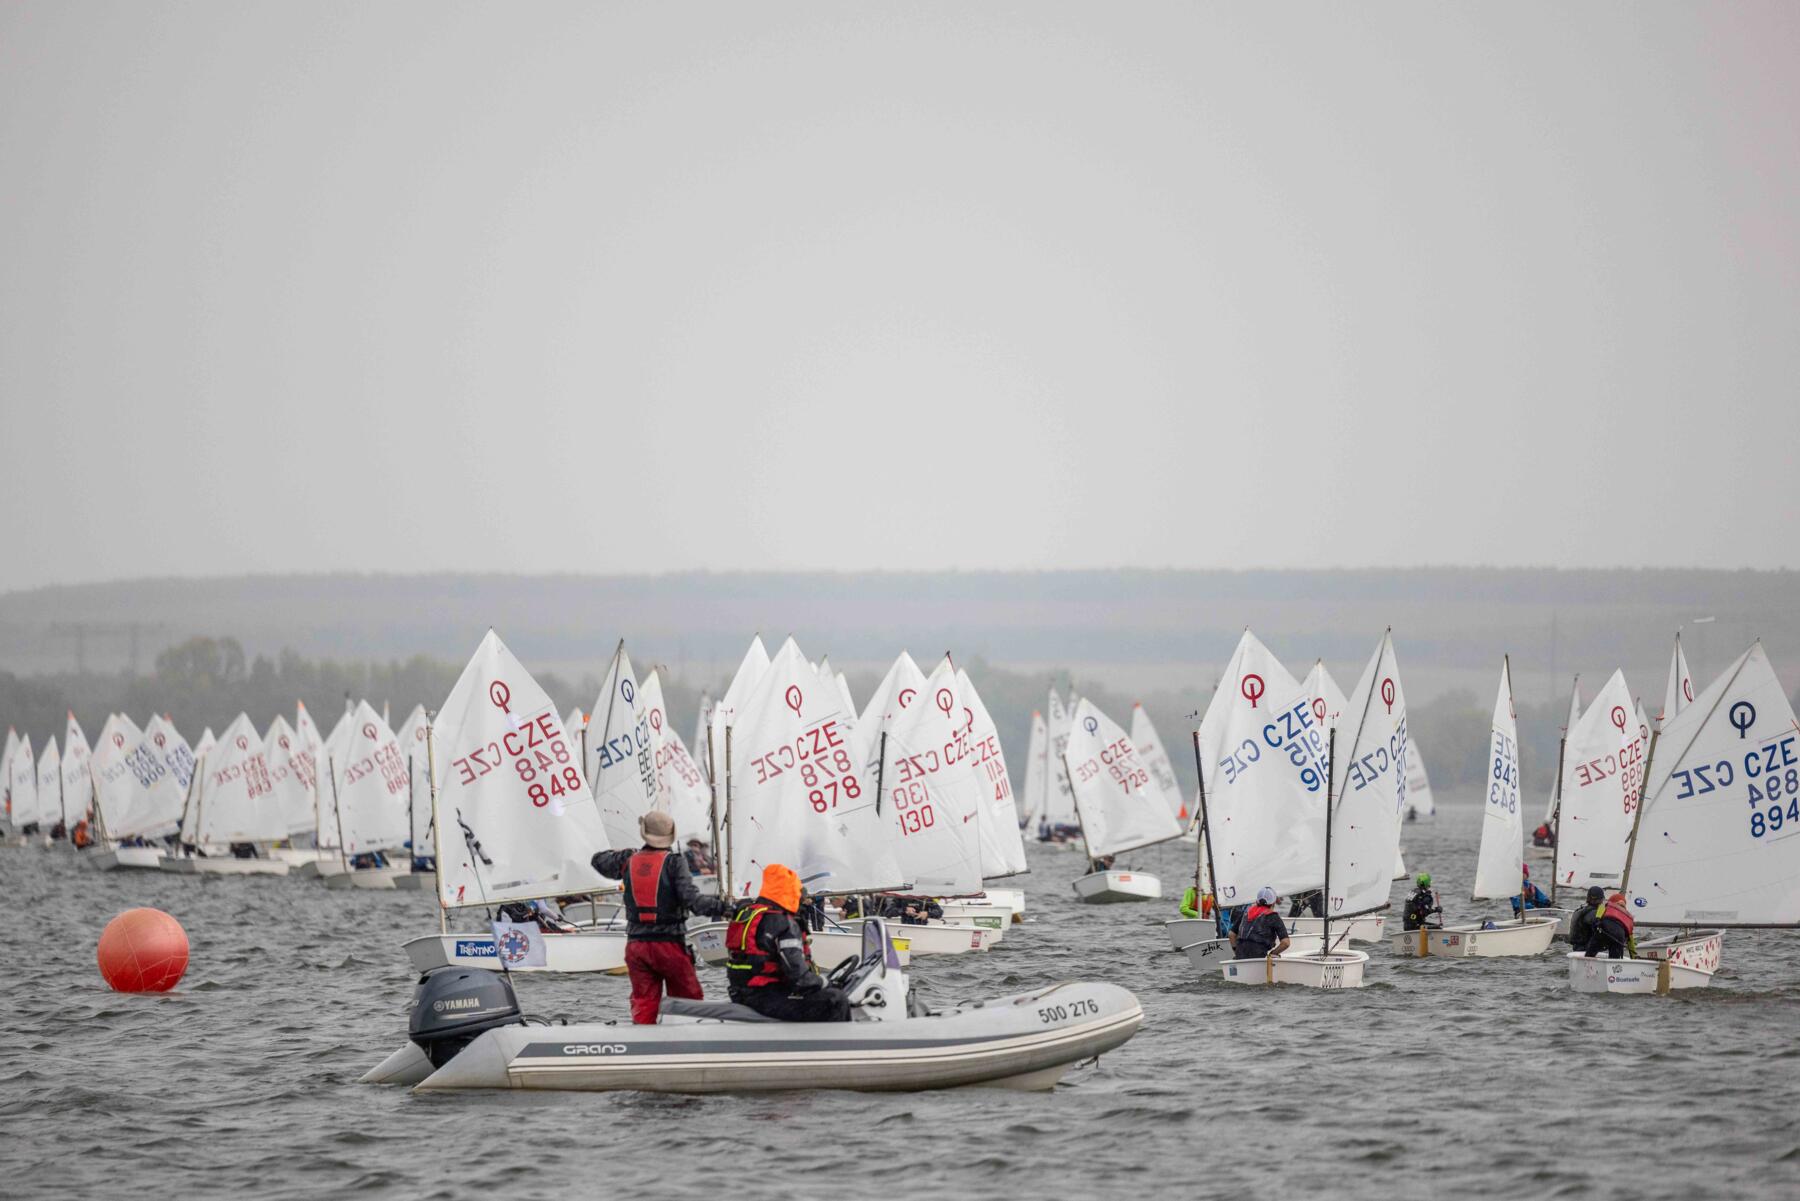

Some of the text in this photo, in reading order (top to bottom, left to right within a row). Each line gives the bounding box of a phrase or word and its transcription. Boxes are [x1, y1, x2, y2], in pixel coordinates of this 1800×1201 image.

[503, 713, 561, 757] CZE
[1263, 701, 1314, 748] CZE
[796, 721, 844, 761] CZE
[944, 733, 969, 765] CZE
[1100, 738, 1132, 765] CZE
[1619, 739, 1642, 769] CZE
[1744, 737, 1798, 778] CZE
[528, 767, 581, 808] 848
[994, 777, 1010, 801] 411
[1118, 768, 1149, 795] 728
[1493, 758, 1517, 790] 843
[809, 775, 861, 813] 878
[899, 804, 934, 836] 130
[1751, 797, 1800, 838] 894
[444, 998, 480, 1011] YAMAHA
[1038, 999, 1099, 1023] 500 276
